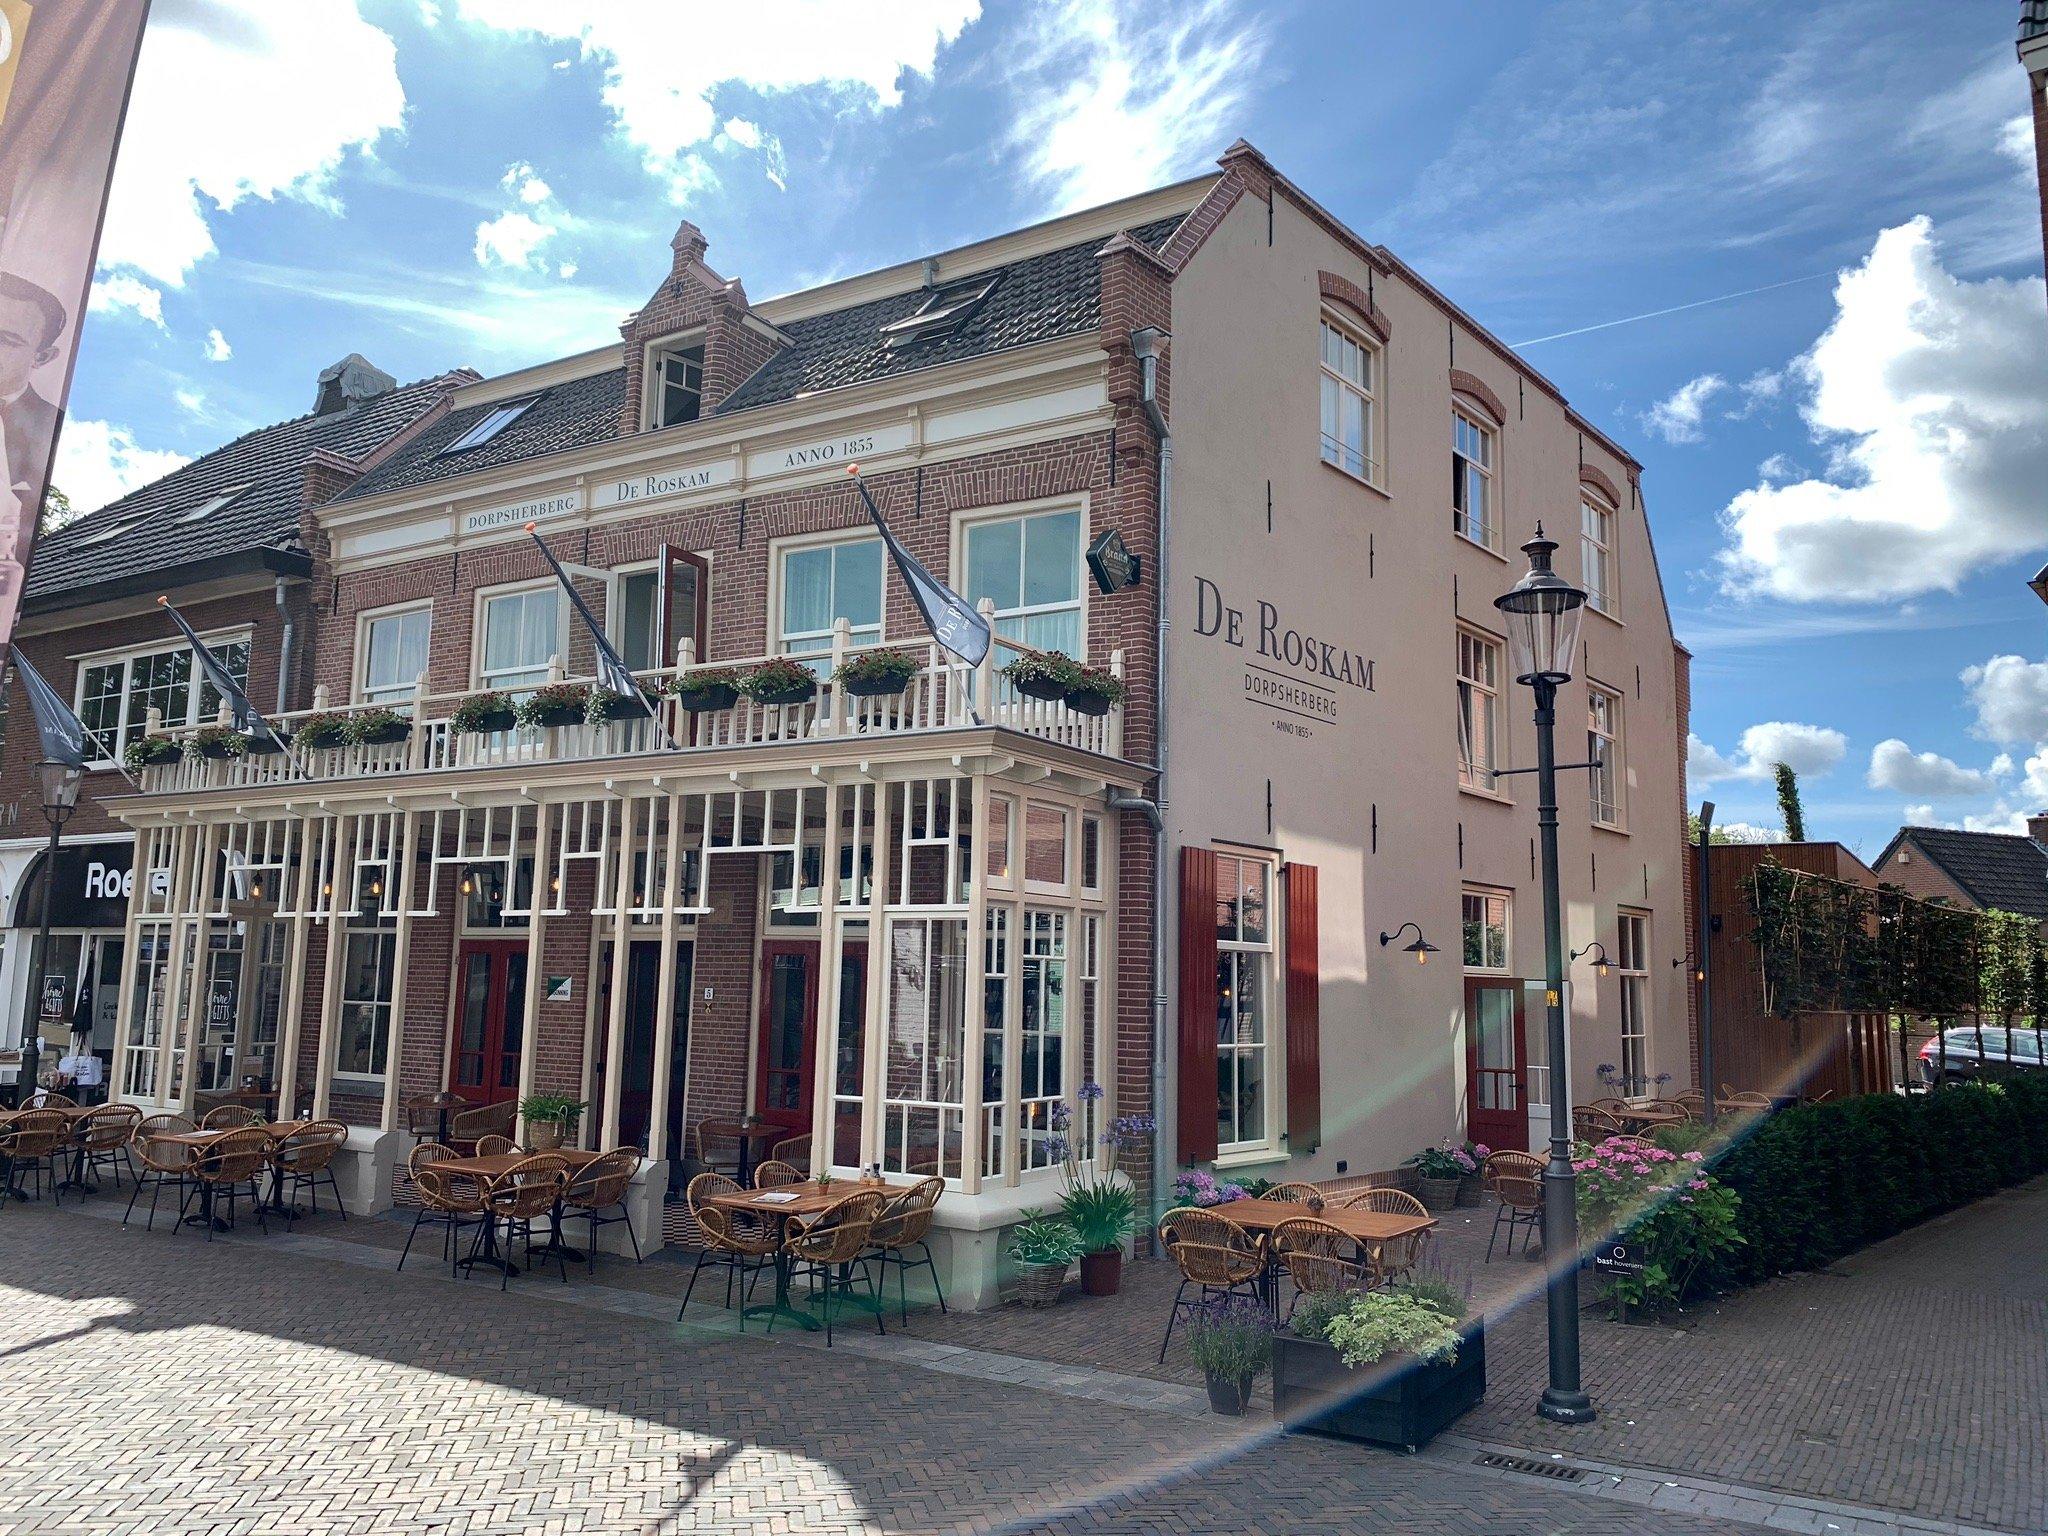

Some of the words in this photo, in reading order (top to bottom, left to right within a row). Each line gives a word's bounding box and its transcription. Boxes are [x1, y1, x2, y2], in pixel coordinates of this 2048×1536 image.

[785, 446, 834, 467] ANNO
[843, 437, 873, 455] 1855
[617, 482, 638, 501] DE
[646, 472, 710, 495] ROSKAM
[469, 498, 574, 528] DORPSHERBERG
[1194, 576, 1244, 648] DE
[1256, 600, 1376, 692] ROSKAM
[1245, 674, 1336, 716] DORPSHERBERG
[1277, 721, 1294, 734] ANNO
[1295, 725, 1308, 738] 1855
[706, 989, 711, 998] 5
[1596, 1256, 1612, 1266] bast
